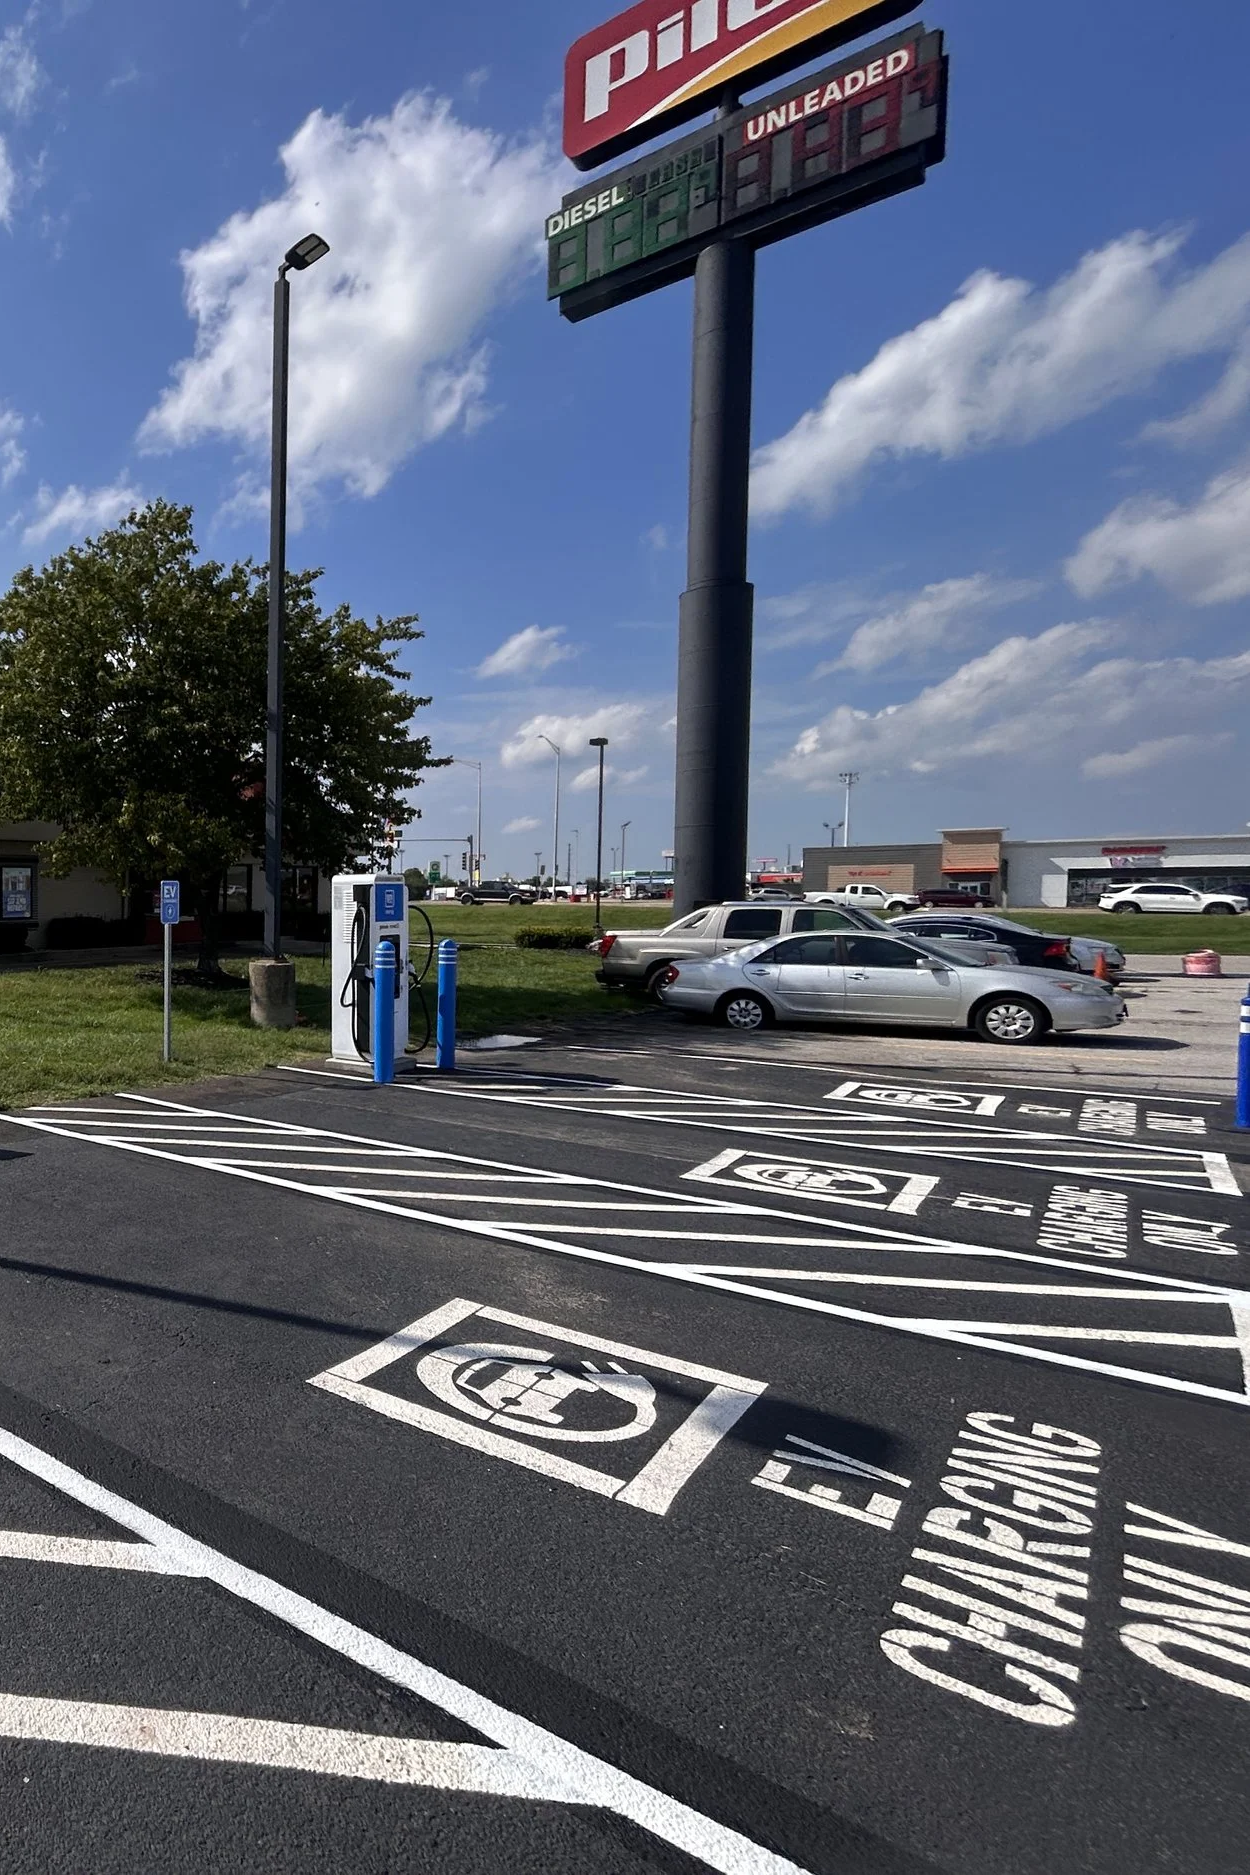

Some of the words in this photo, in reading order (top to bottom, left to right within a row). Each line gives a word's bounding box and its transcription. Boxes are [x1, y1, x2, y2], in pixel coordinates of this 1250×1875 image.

[746, 48, 910, 141] UNLEADED
[547, 186, 625, 238] DIESEL
[163, 885, 176, 898] EV
[951, 1191, 1034, 1218] EV
[1036, 1184, 1129, 1259] CHARGING
[1141, 1208, 1239, 1256] ONLY
[750, 1433, 912, 1531] EV
[879, 1411, 1102, 1727] CHARGING
